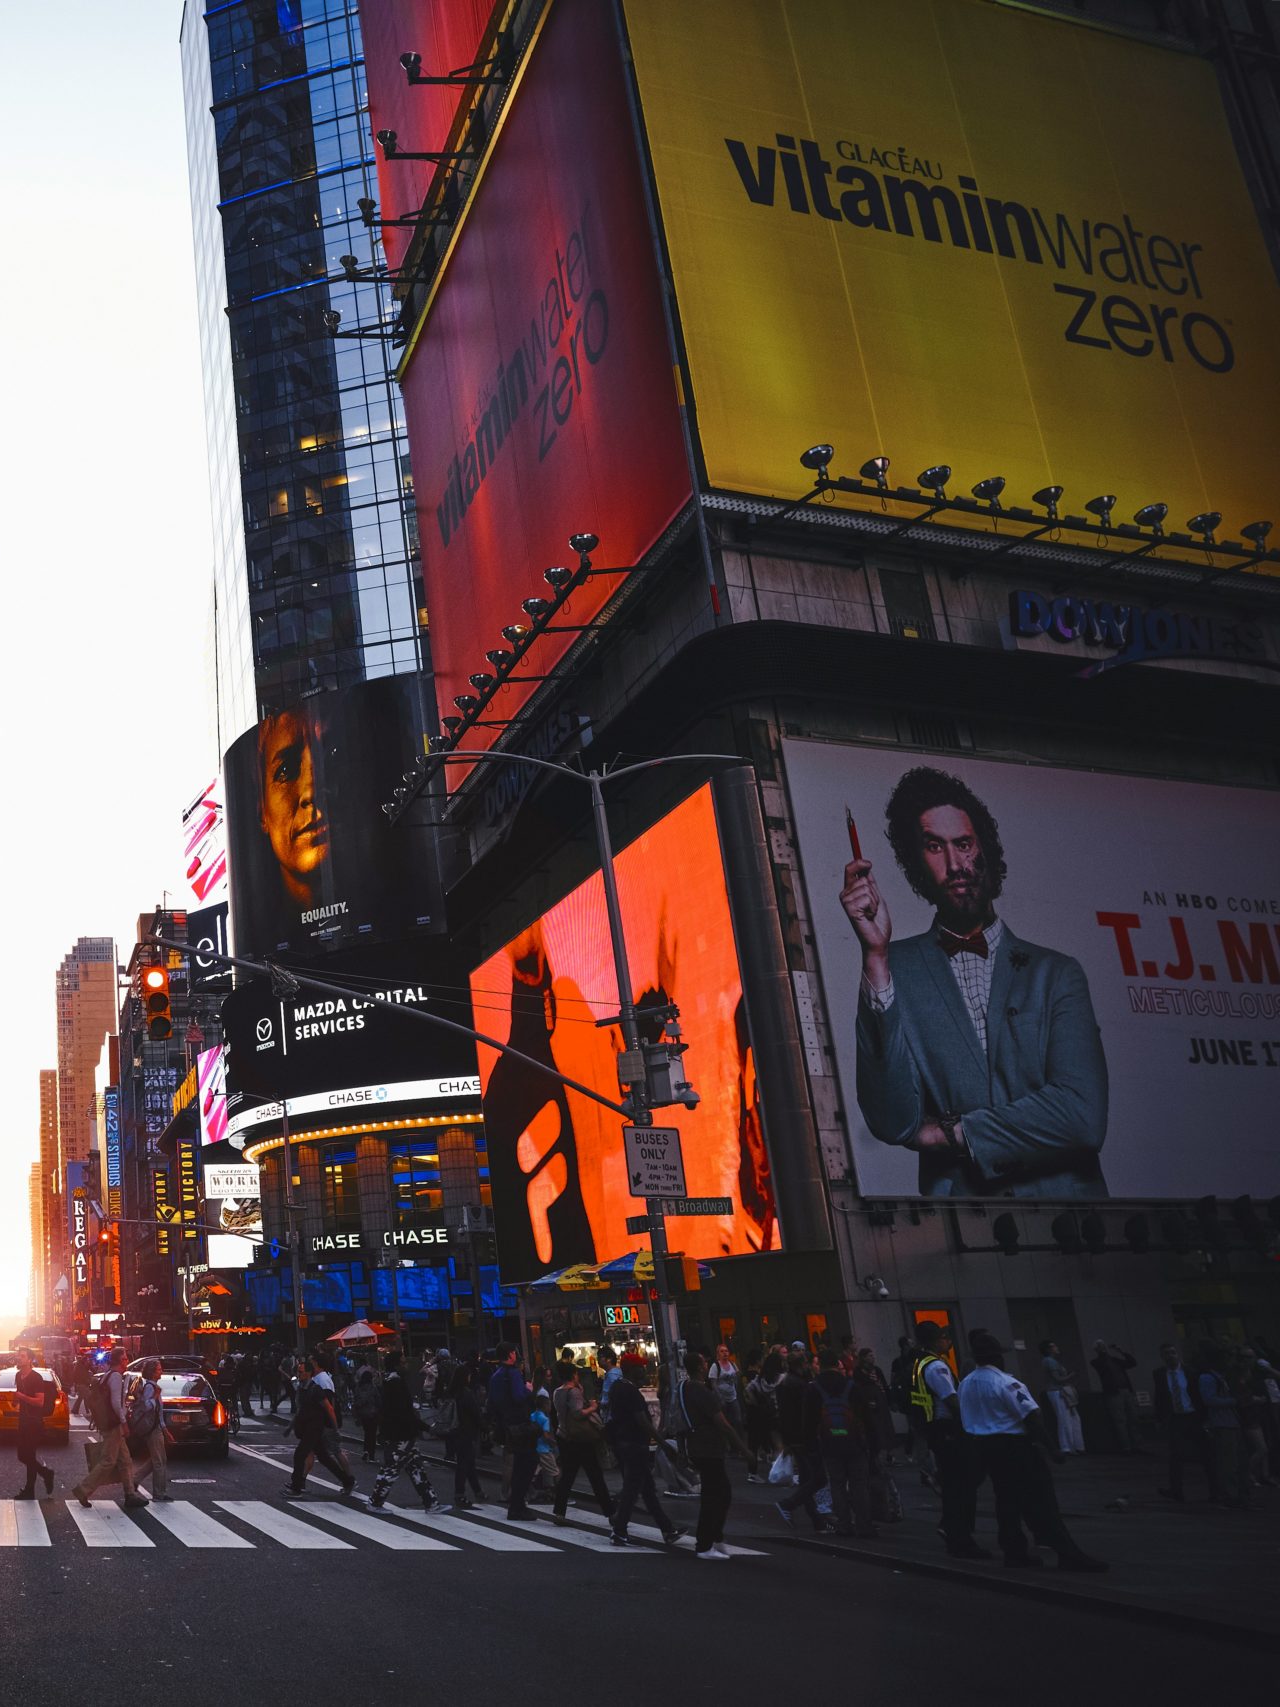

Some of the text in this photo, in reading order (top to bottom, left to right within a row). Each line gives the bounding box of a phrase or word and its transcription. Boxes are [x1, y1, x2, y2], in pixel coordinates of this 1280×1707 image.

[1053, 283, 1235, 374] zero
[533, 289, 609, 462] zero
[1142, 891, 1167, 907] AN
[1175, 893, 1217, 910] HBO
[1095, 911, 1280, 985] T.J. M
[294, 998, 347, 1022] MAZDA
[295, 1015, 365, 1040] SERVICES
[1189, 1038, 1258, 1066] JUNE
[329, 1090, 372, 1105] CHASE
[256, 1104, 283, 1120] CHASE
[635, 1133, 669, 1146] BUSES
[641, 1148, 666, 1160] ONLY
[108, 1145, 121, 1187] STUDIOS
[181, 1143, 195, 1201] VICTORY
[212, 1176, 258, 1187] WORK
[110, 1191, 122, 1215] DUKE
[678, 1200, 729, 1215] Broadway
[73, 1200, 87, 1282] REGAL
[158, 1230, 169, 1254] NEW
[312, 1233, 361, 1251] CHASE
[383, 1228, 449, 1246] CHASE
[177, 1263, 209, 1275] SKCHERS
[606, 1306, 640, 1325] SODA
